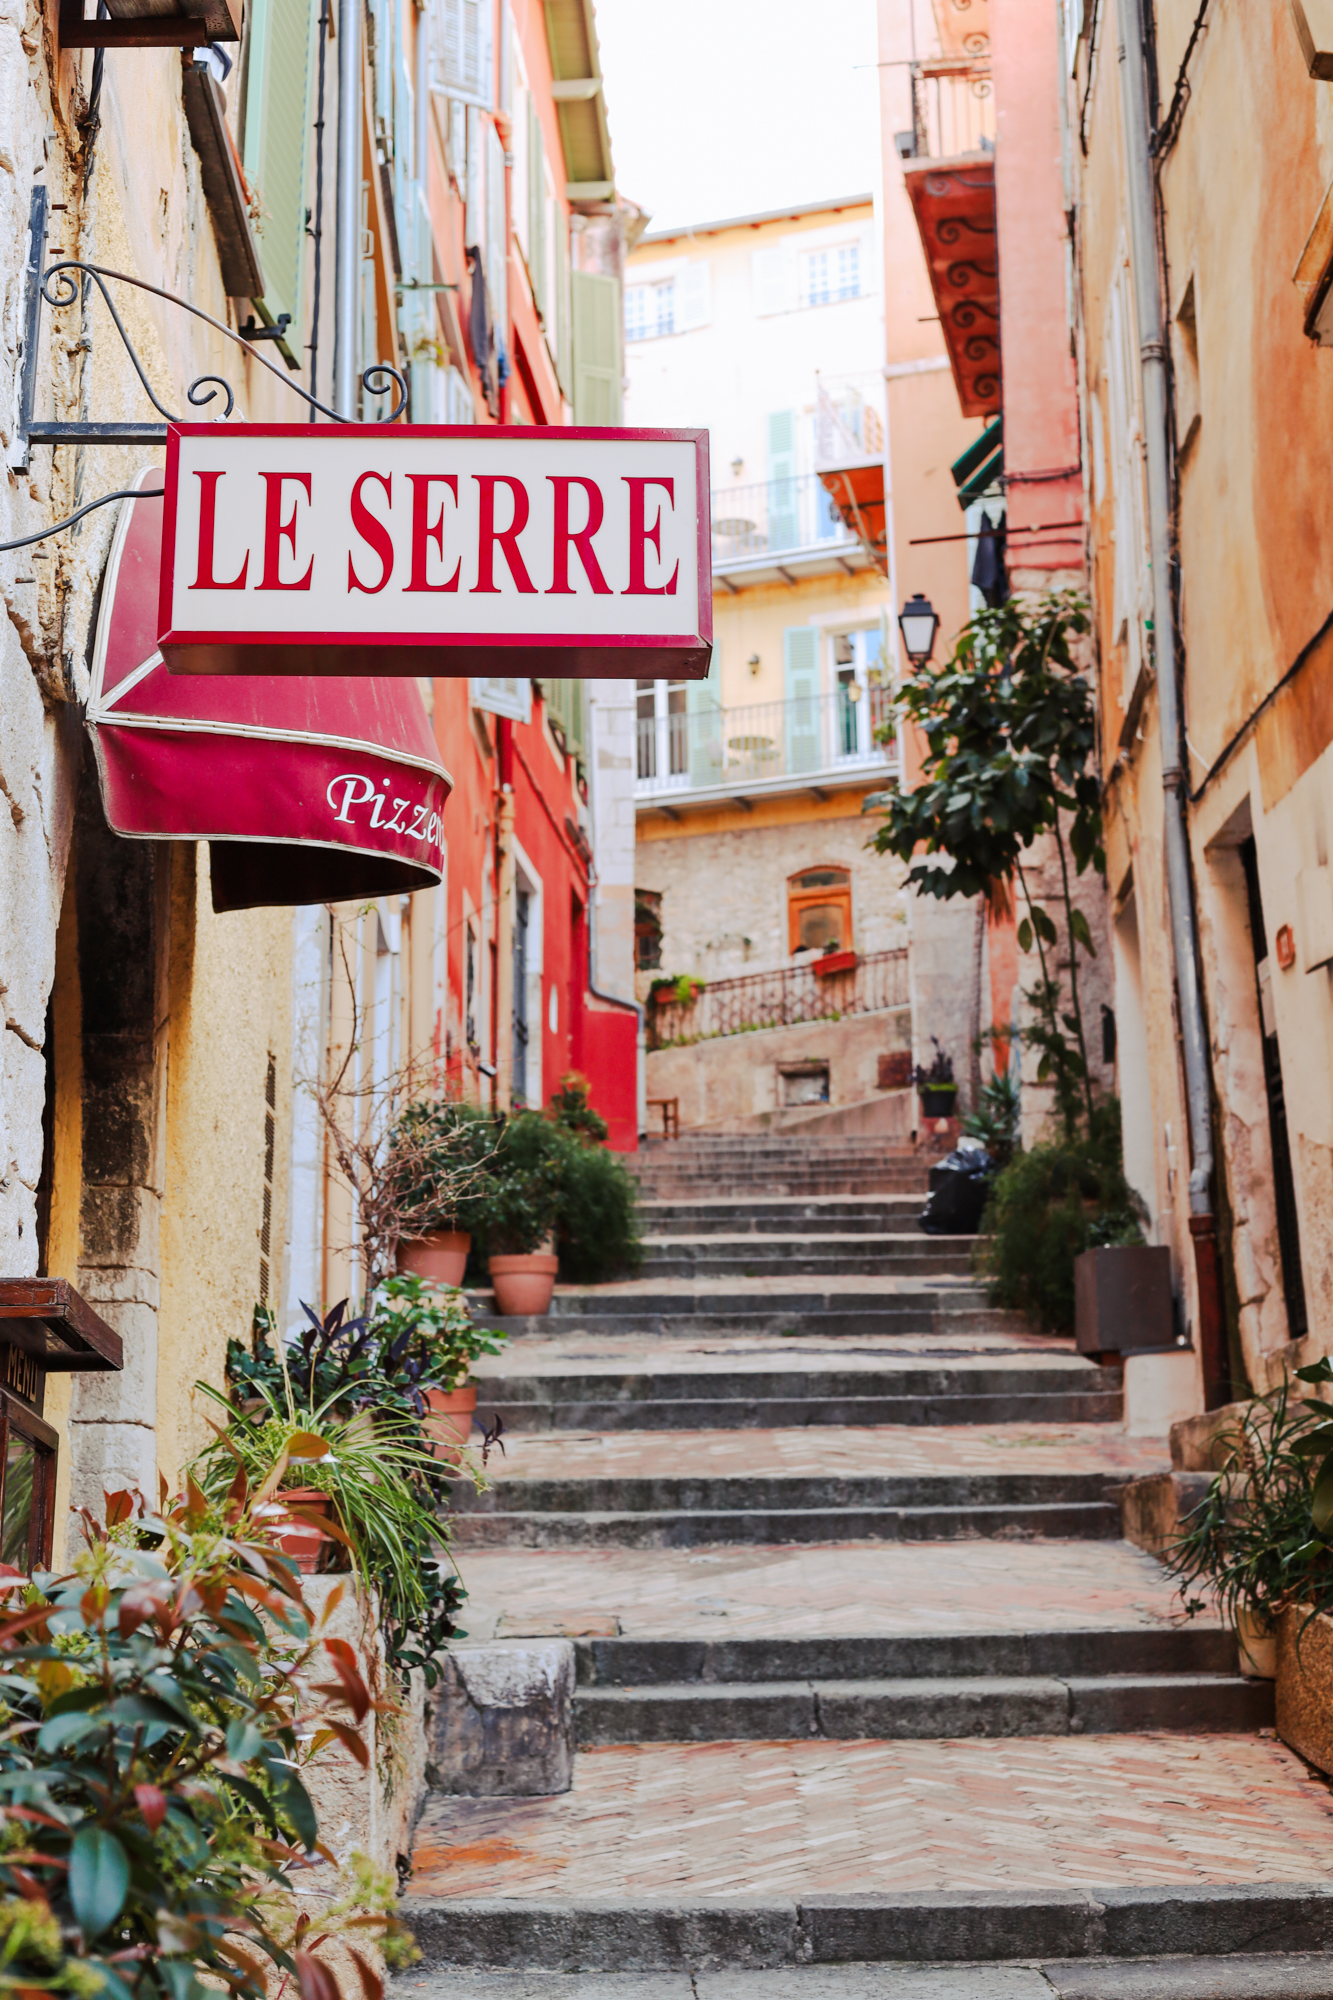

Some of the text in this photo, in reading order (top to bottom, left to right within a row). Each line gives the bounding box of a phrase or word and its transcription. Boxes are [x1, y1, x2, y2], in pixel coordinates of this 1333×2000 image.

[187, 470, 679, 596] LE SERRE
[7, 1342, 38, 1403] MENU
